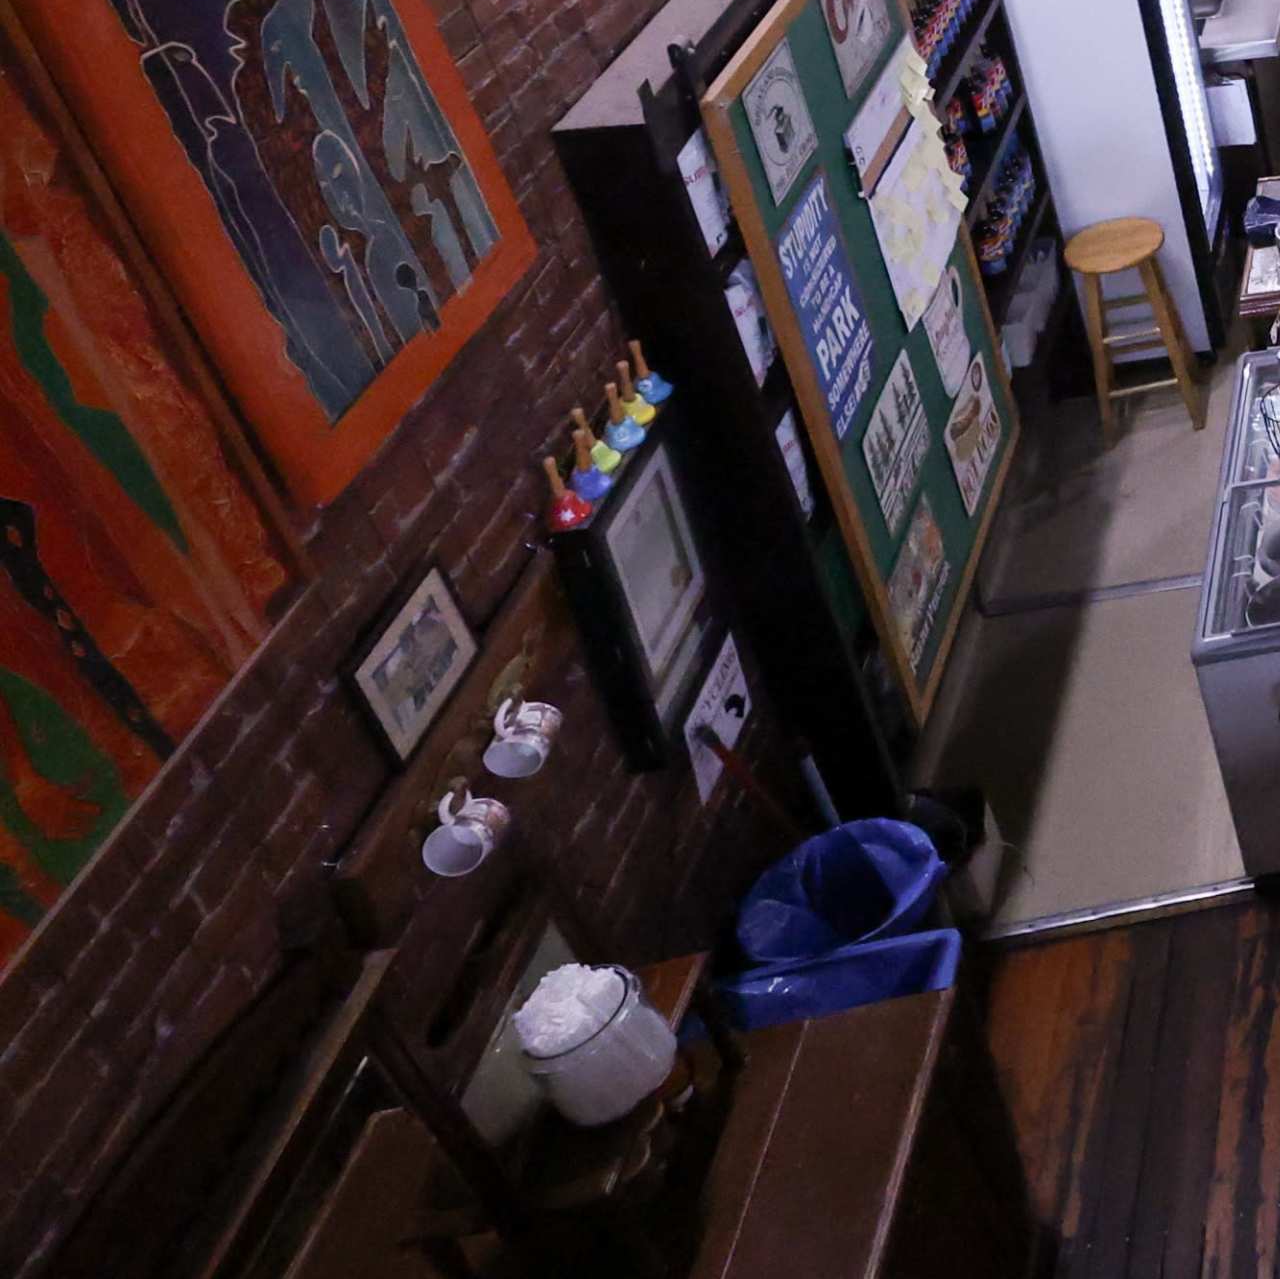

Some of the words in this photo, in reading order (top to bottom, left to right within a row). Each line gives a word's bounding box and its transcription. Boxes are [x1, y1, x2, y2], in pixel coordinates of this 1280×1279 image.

[777, 176, 828, 279] STUPIDITY
[815, 283, 860, 383] PARK
[826, 316, 870, 414] SOMEWHERE
